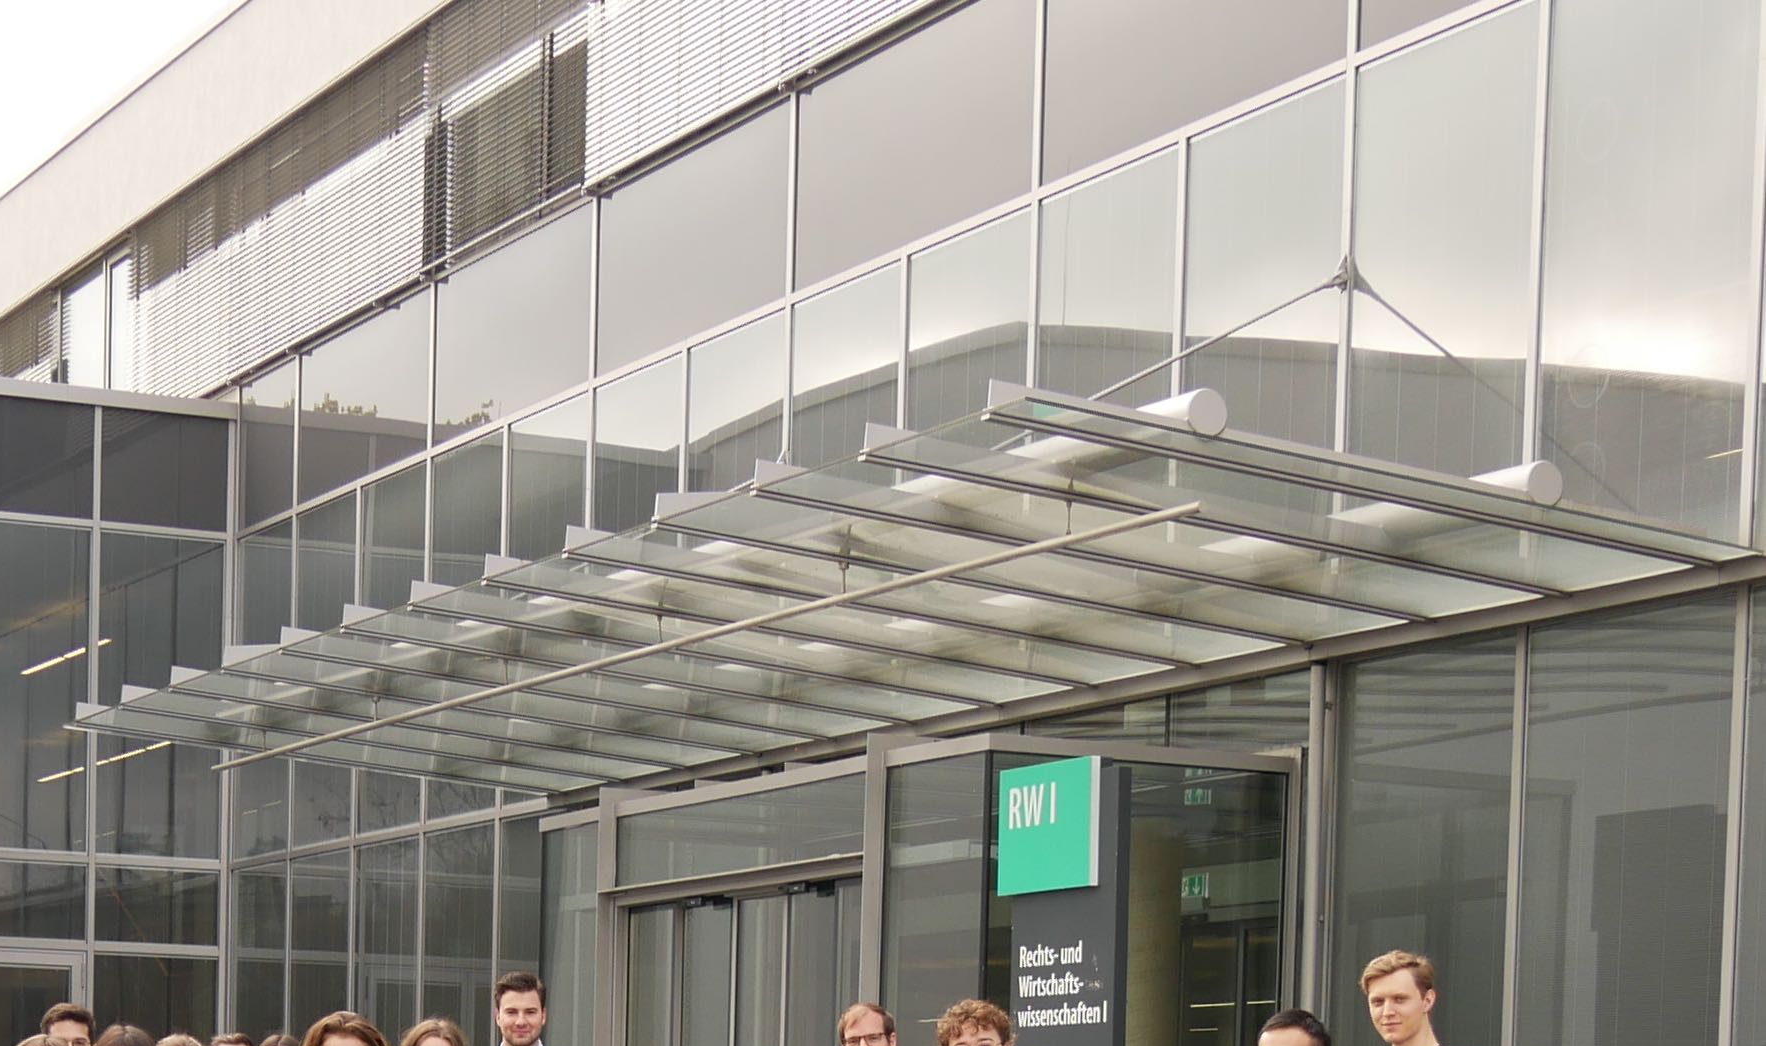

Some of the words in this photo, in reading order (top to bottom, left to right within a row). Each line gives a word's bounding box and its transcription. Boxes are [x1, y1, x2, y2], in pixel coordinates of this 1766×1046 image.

[1008, 783, 1045, 830] RW
[1050, 781, 1057, 824] I
[1019, 943, 1059, 968] Rechts-
[1060, 940, 1083, 965] und
[1018, 971, 1084, 998] Wirtschafts-
[1017, 1001, 1101, 1028] wissenschaften
